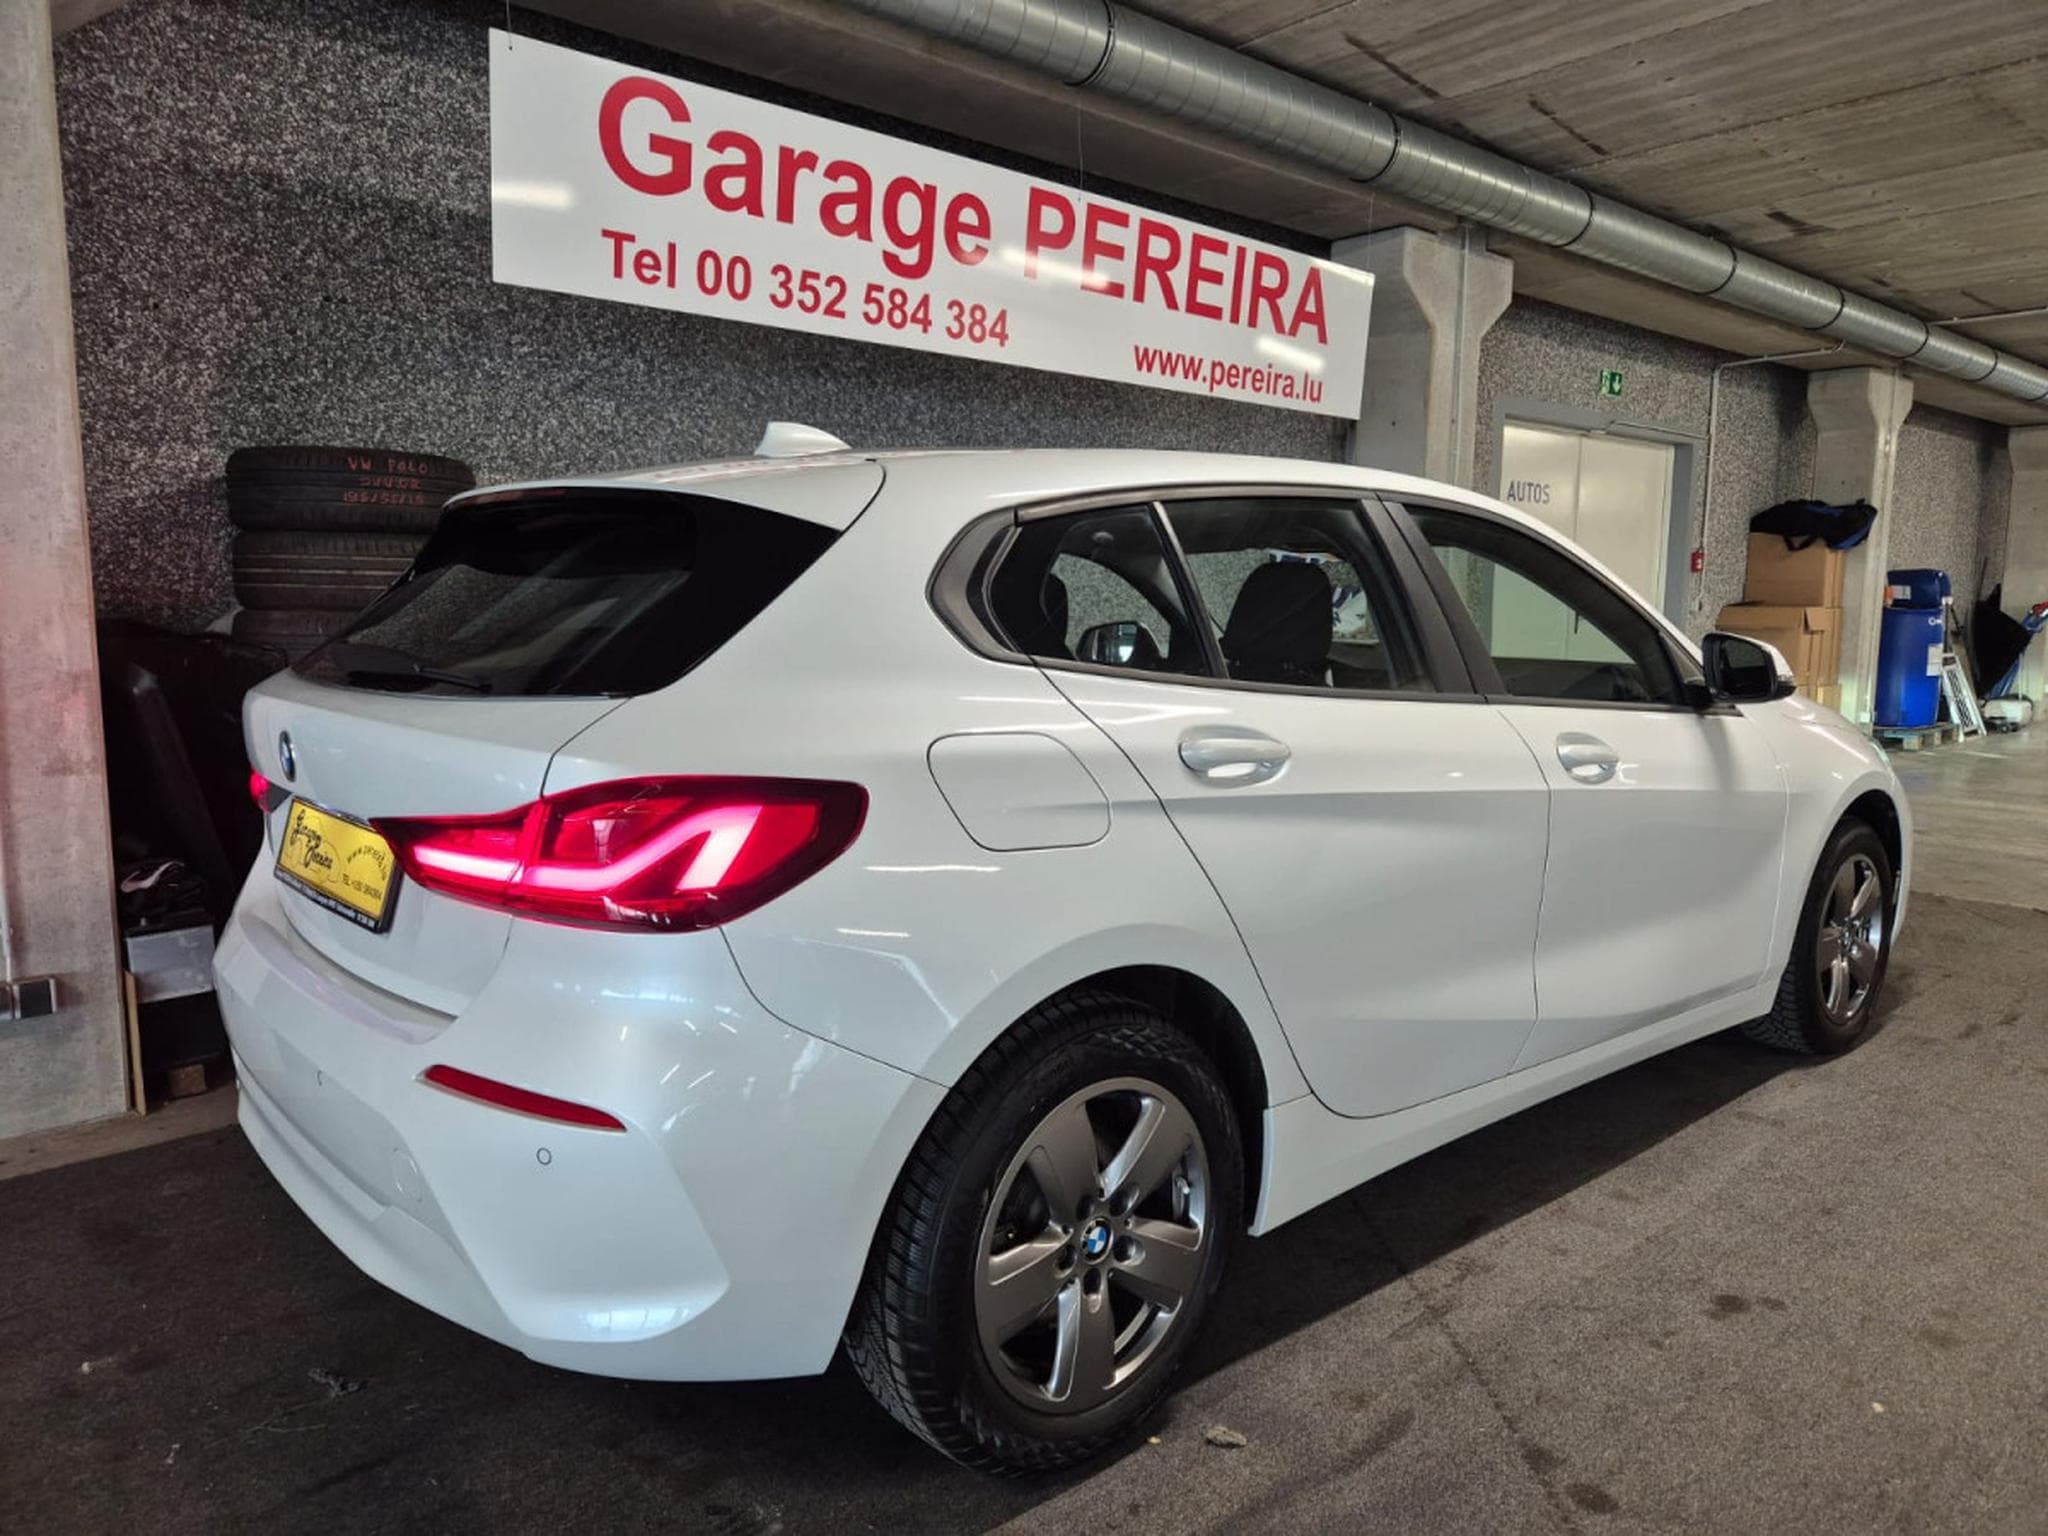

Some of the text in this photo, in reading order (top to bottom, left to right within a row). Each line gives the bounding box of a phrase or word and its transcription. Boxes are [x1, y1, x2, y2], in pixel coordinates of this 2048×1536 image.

[598, 75, 1328, 345] Garage PEREIRA
[601, 228, 1010, 347] Tel 00 352 584 384
[1134, 345, 1323, 403] www.pereira.lu
[347, 456, 429, 474] VW POLO
[1507, 480, 1551, 506] AUTOS
